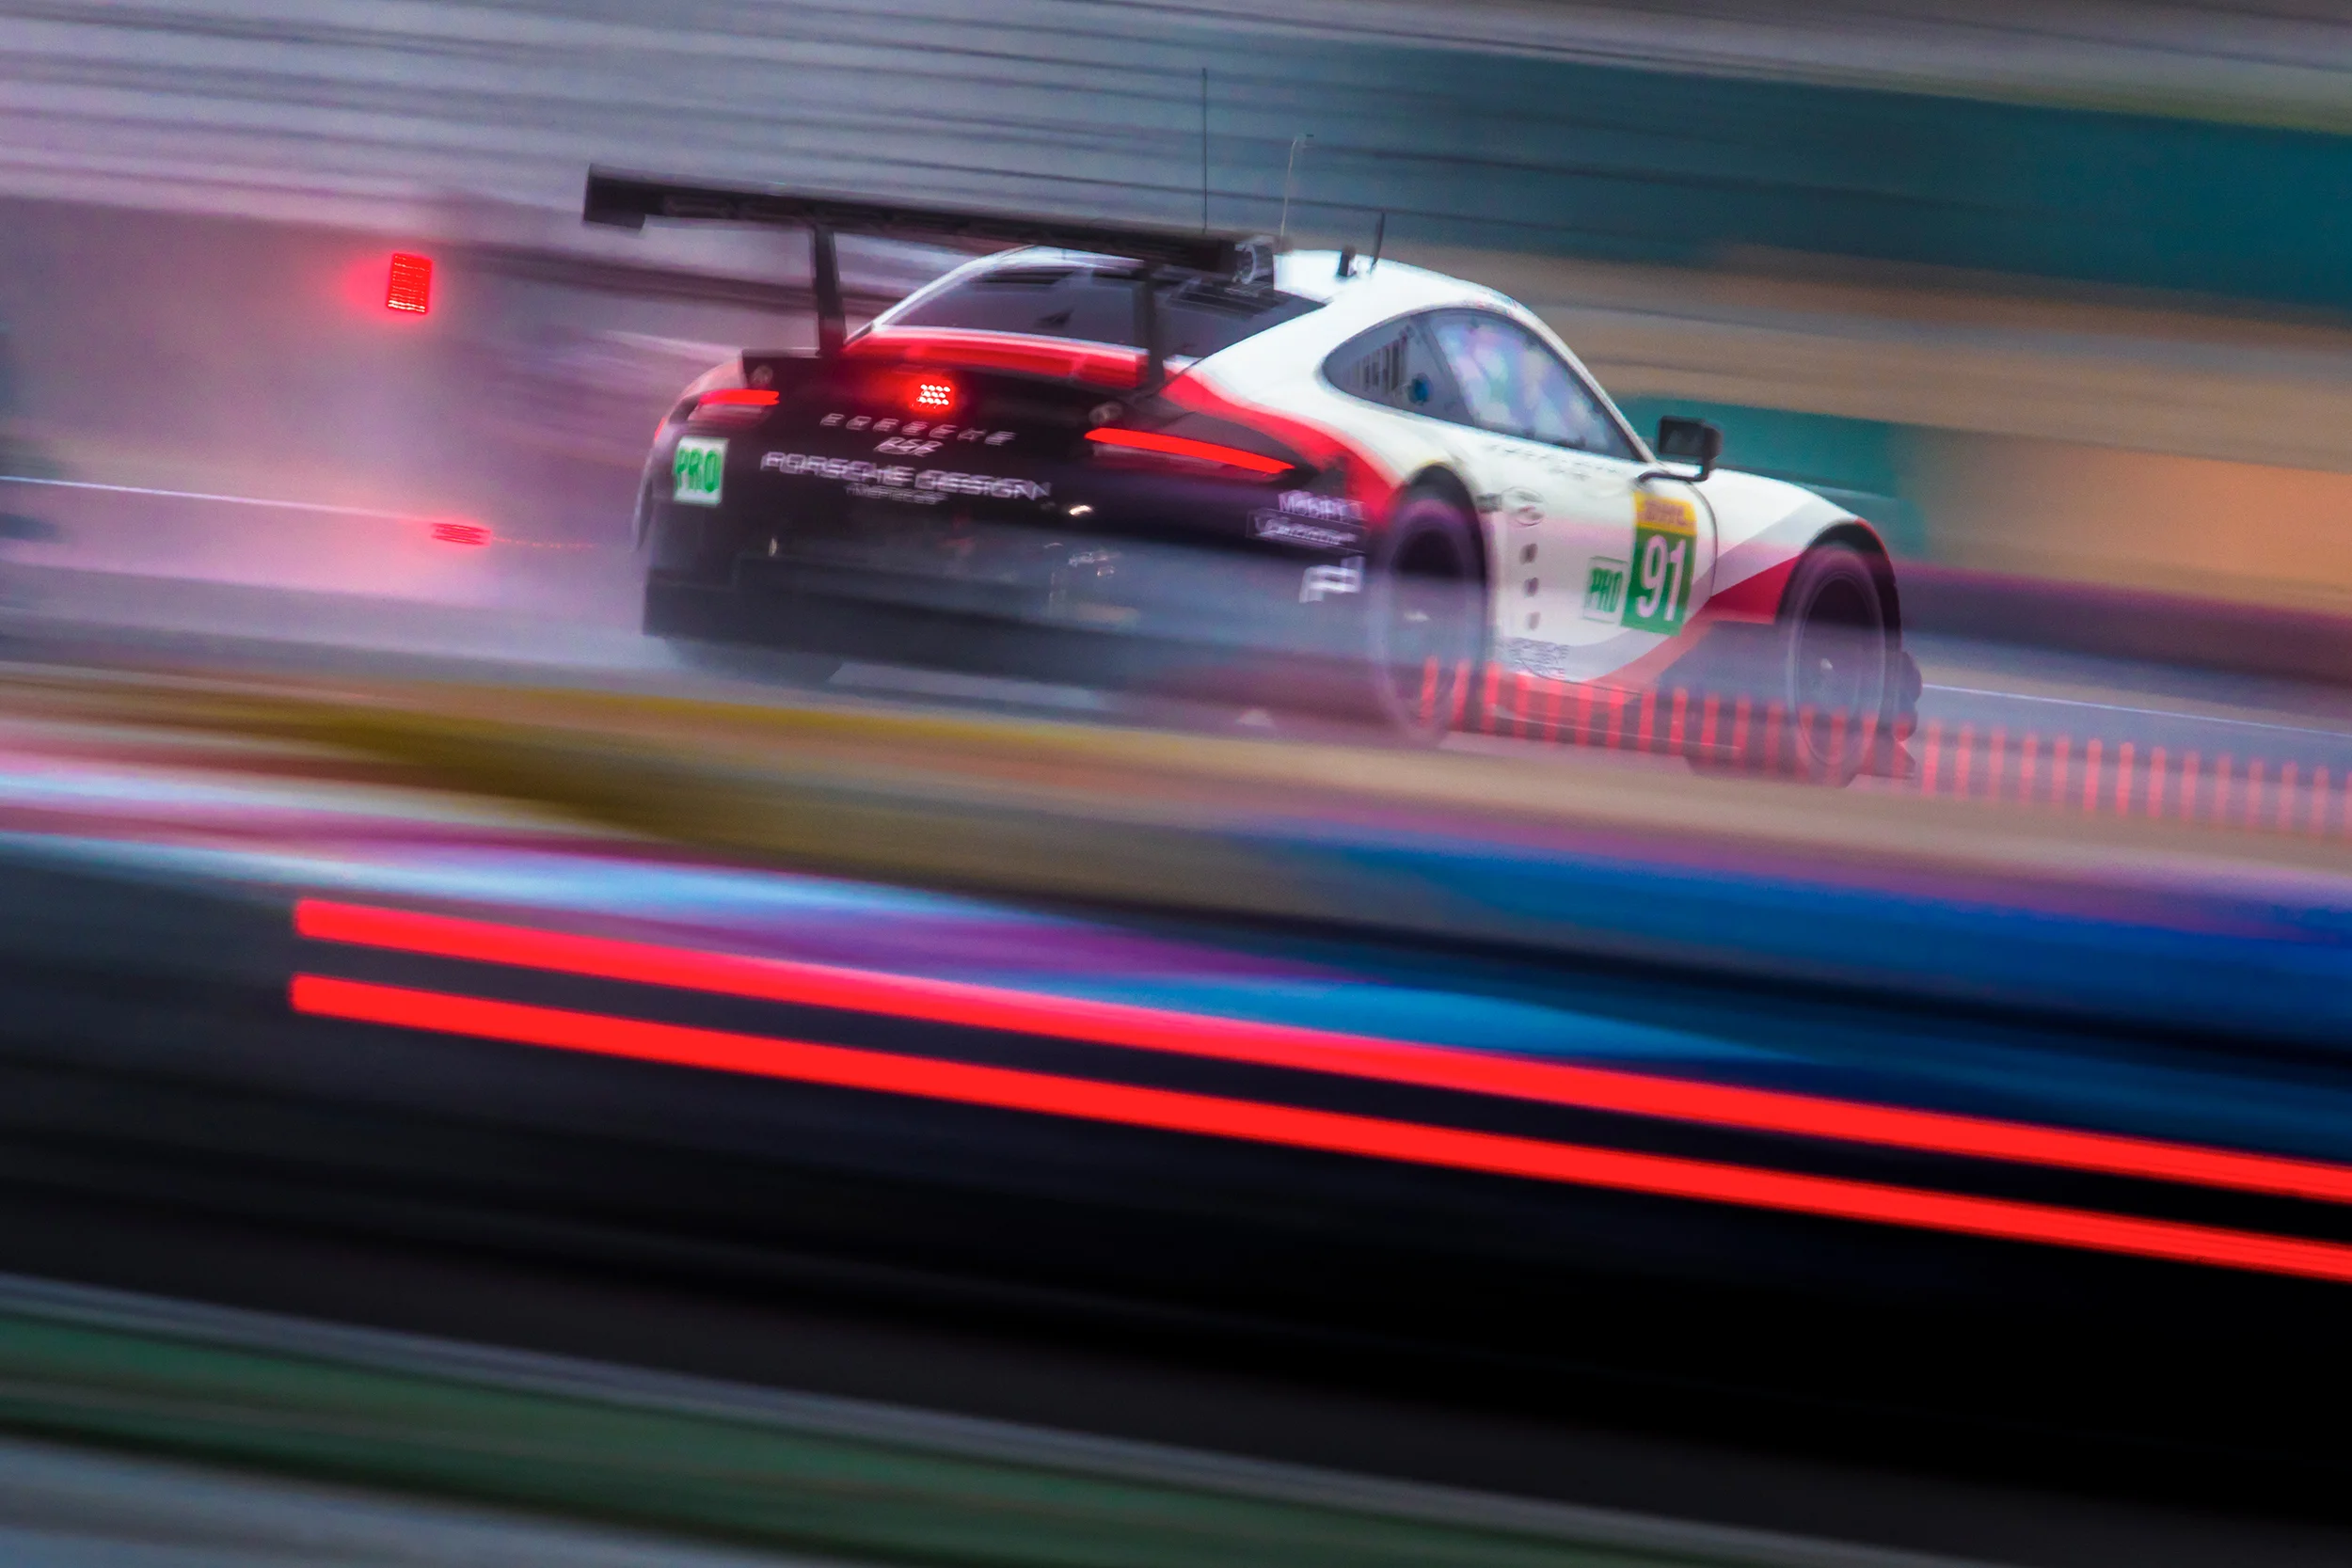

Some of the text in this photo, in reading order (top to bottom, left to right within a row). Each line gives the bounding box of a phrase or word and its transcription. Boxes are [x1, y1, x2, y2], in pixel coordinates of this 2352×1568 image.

[675, 448, 722, 493] PRO
[760, 451, 1052, 500] PORSCHE DESIGN
[1588, 567, 1623, 612] PRO
[1637, 534, 1686, 622] 91
